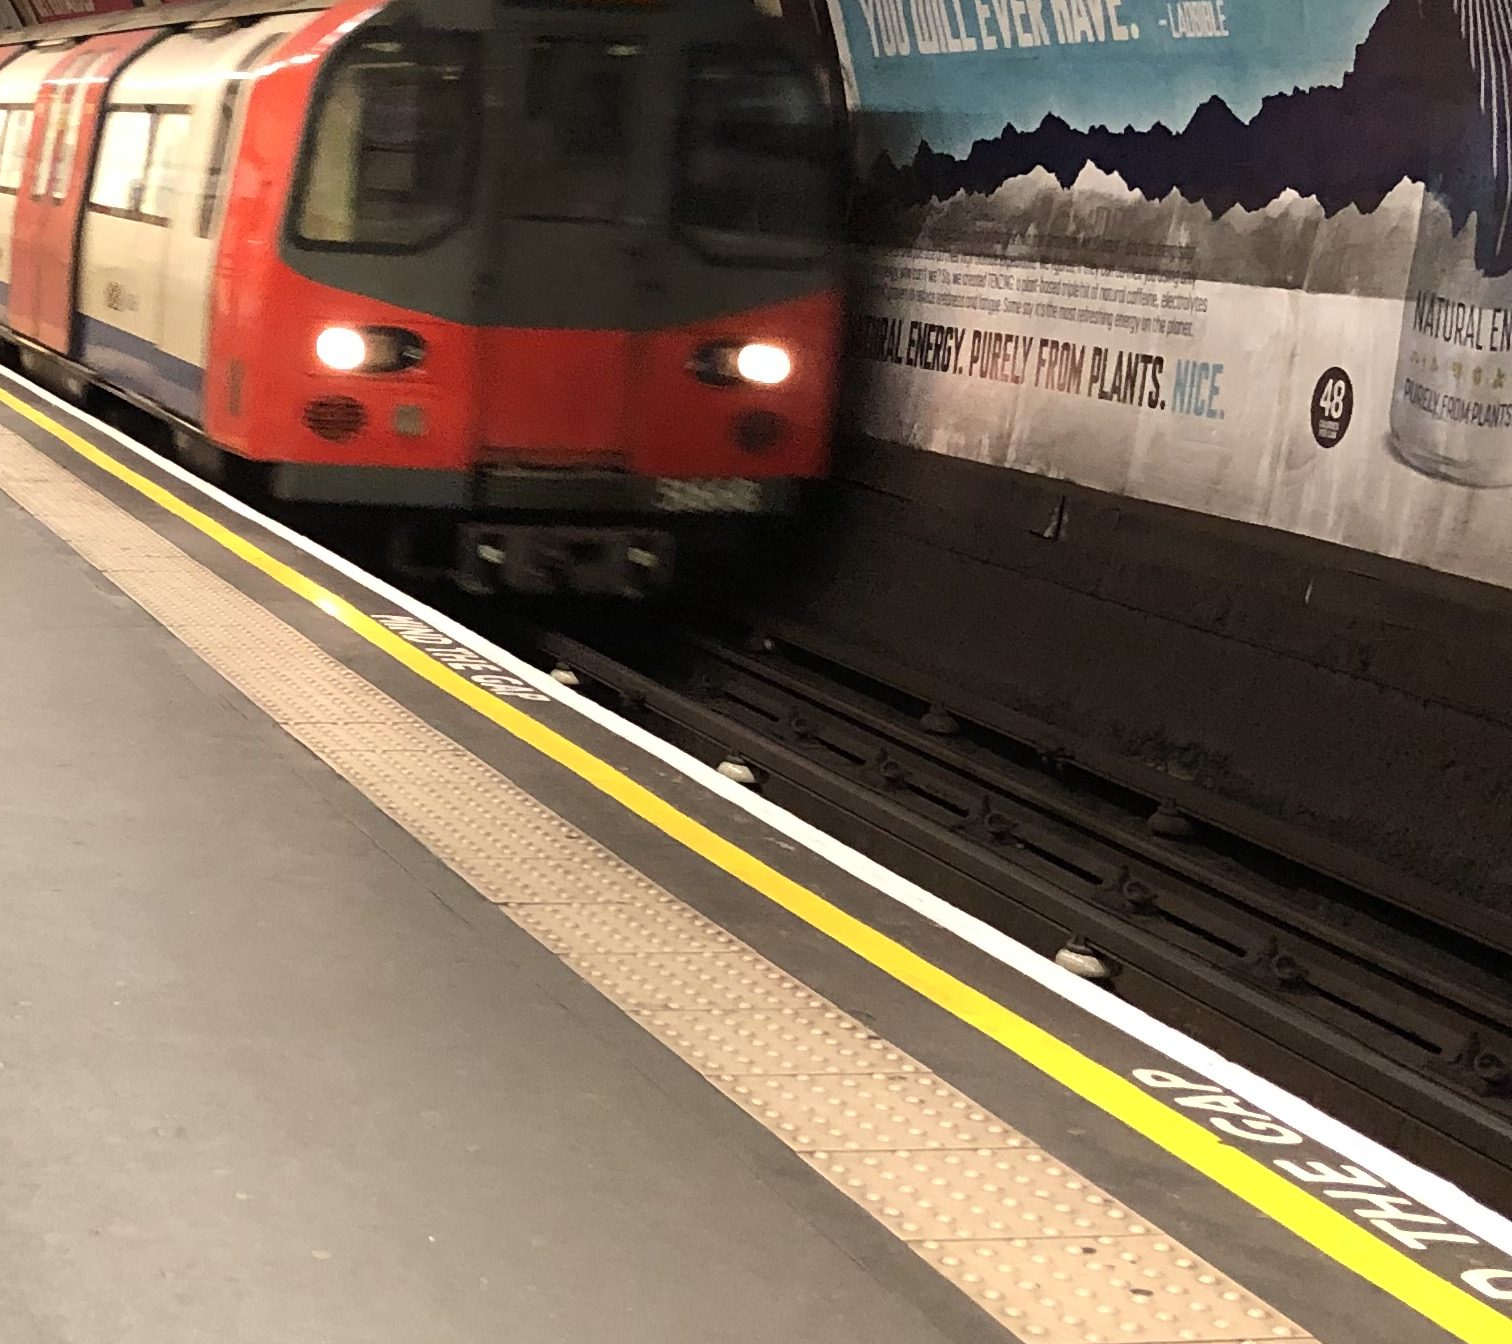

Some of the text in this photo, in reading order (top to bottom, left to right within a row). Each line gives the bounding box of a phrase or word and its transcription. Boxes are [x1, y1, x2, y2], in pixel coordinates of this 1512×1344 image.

[1413, 289, 1483, 351] NATURAL
[905, 320, 967, 375] ENERGY.
[969, 330, 1034, 385] PURELY
[1034, 337, 1086, 395] FROM
[1088, 346, 1166, 411] PLANTS.
[1171, 358, 1225, 420] NICE.
[1319, 377, 1346, 419] 48
[1404, 377, 1441, 420] PURELY
[370, 613, 552, 702] MIND THE GAP
[1132, 1068, 1480, 1251] THE GAP
